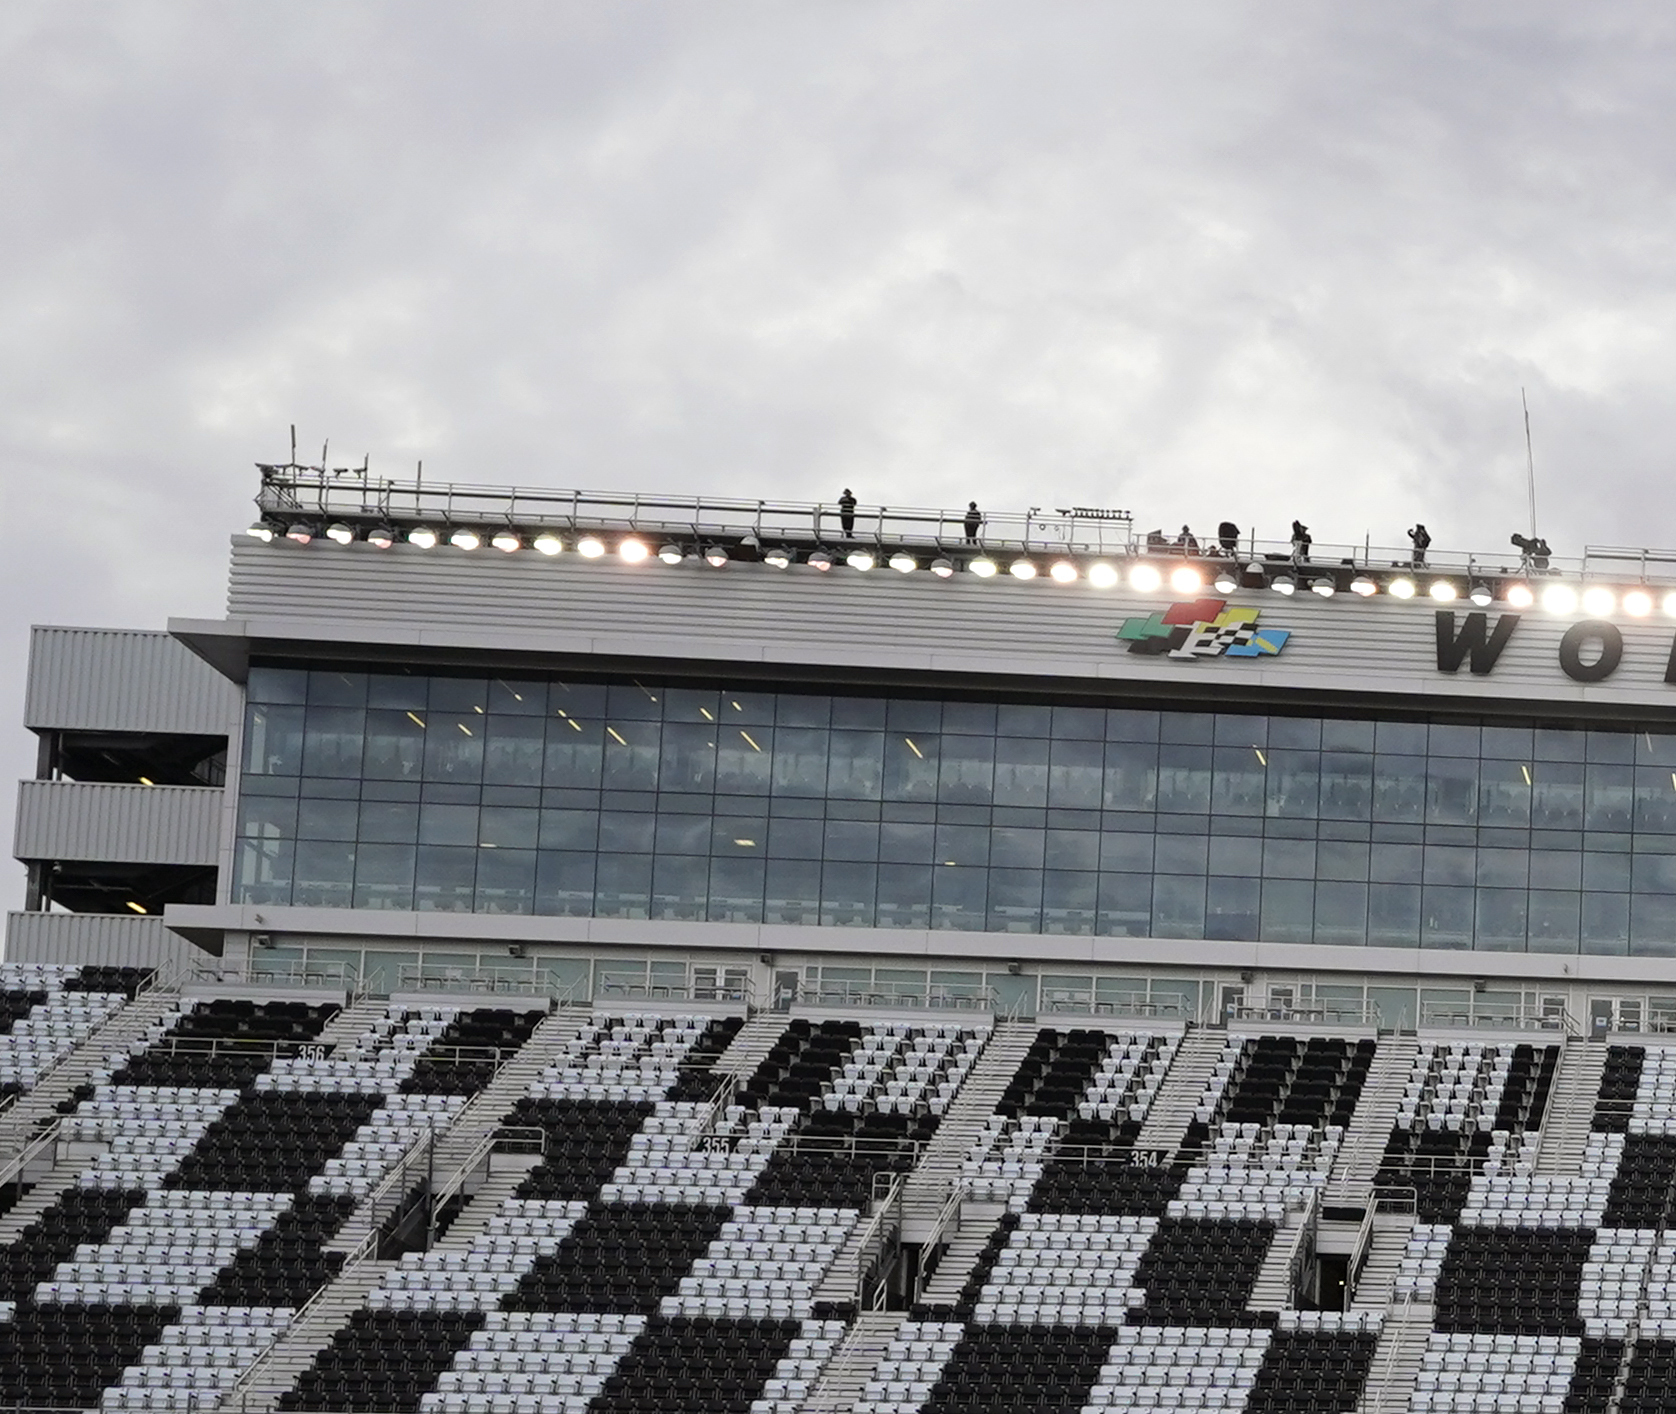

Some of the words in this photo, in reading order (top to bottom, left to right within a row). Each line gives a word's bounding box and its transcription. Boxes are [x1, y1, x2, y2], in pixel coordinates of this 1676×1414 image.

[298, 1045, 325, 1060] 356
[703, 1136, 729, 1153] 355
[1130, 1150, 1157, 1168] 354
